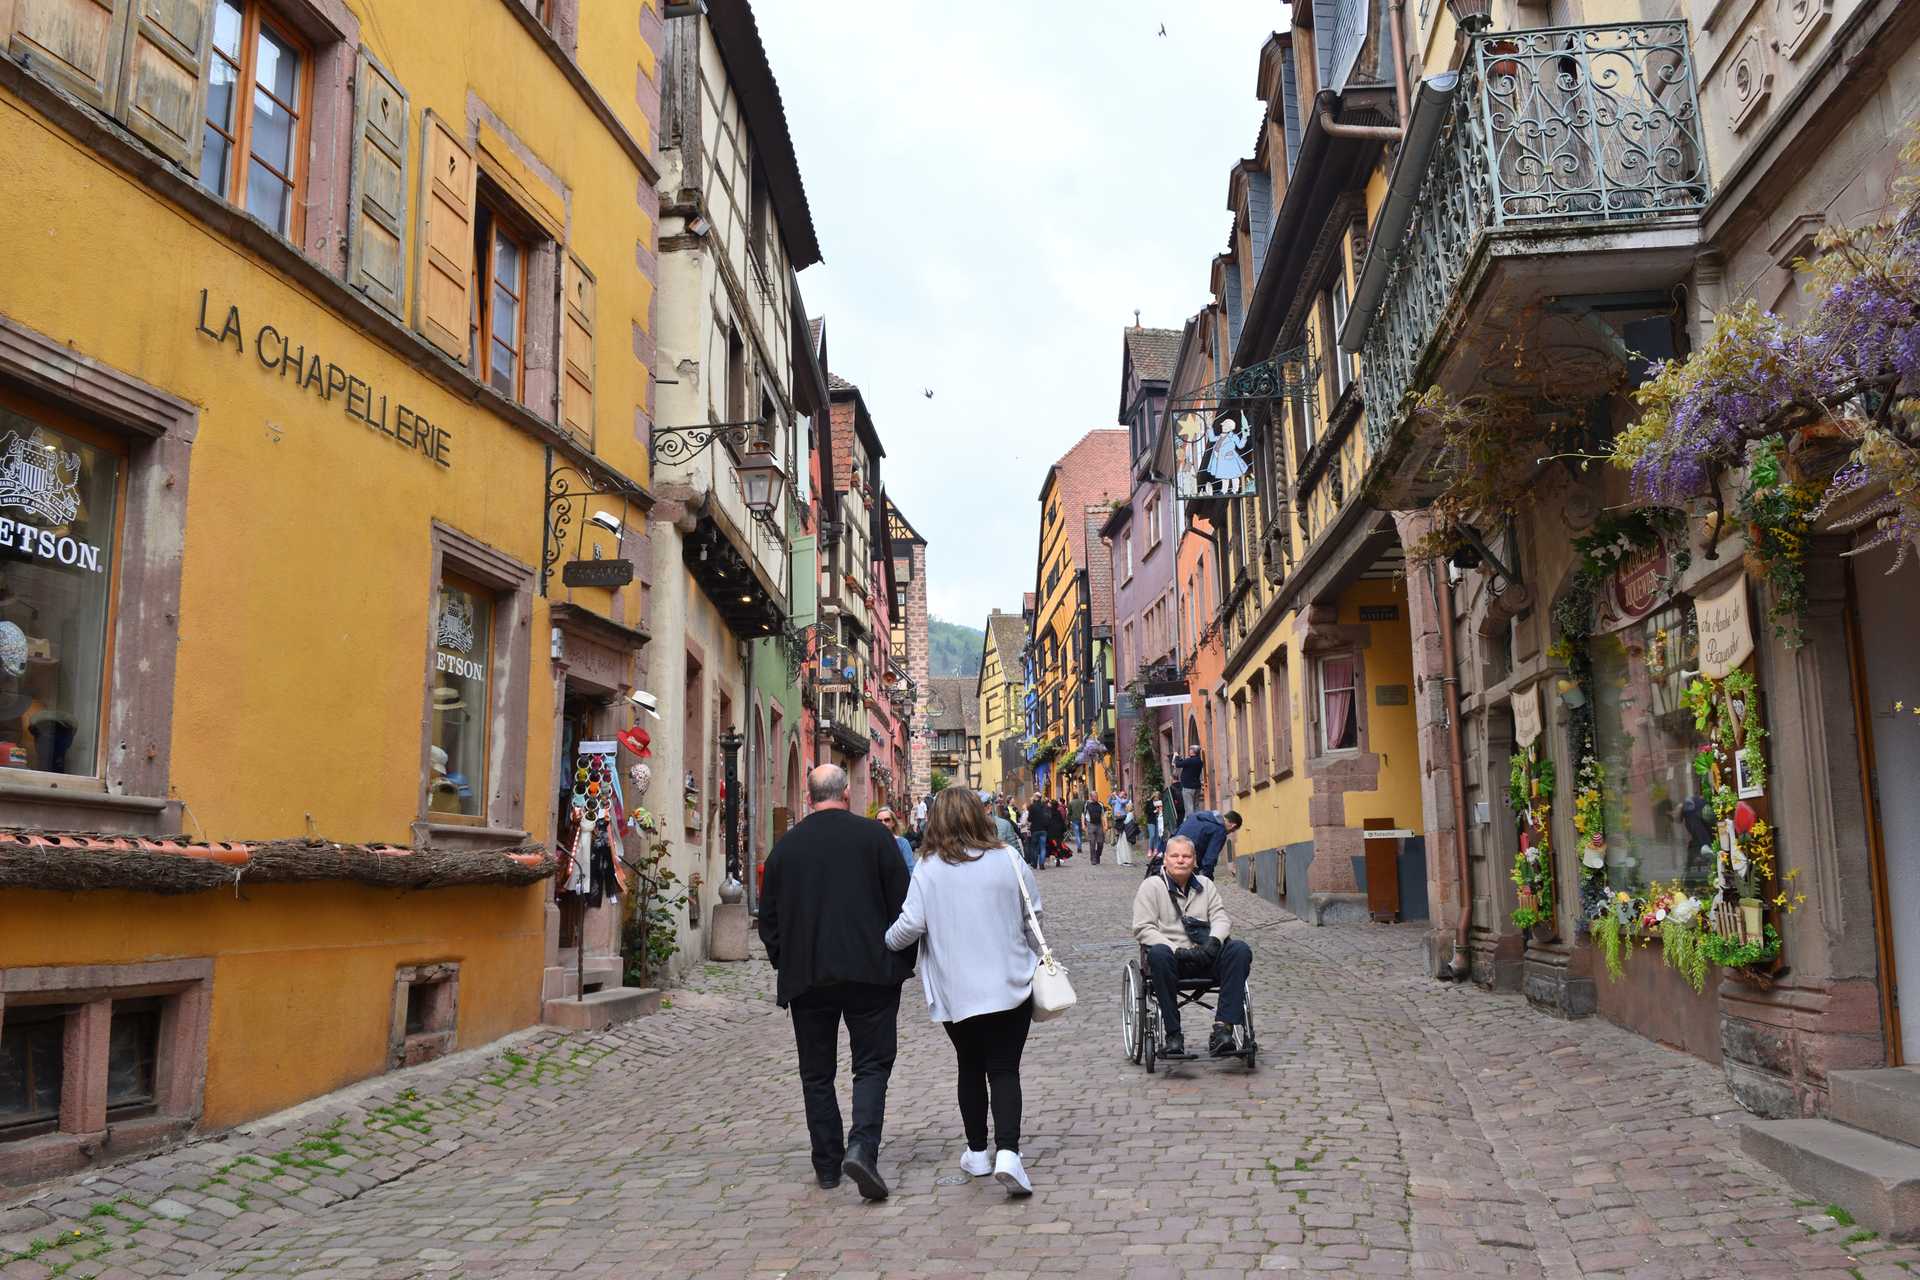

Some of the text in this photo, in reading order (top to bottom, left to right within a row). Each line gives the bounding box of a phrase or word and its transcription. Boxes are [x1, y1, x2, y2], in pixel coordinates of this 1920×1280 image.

[197, 287, 452, 468] LA CHAPELLERIE
[31, 502, 58, 521] AMERICA
